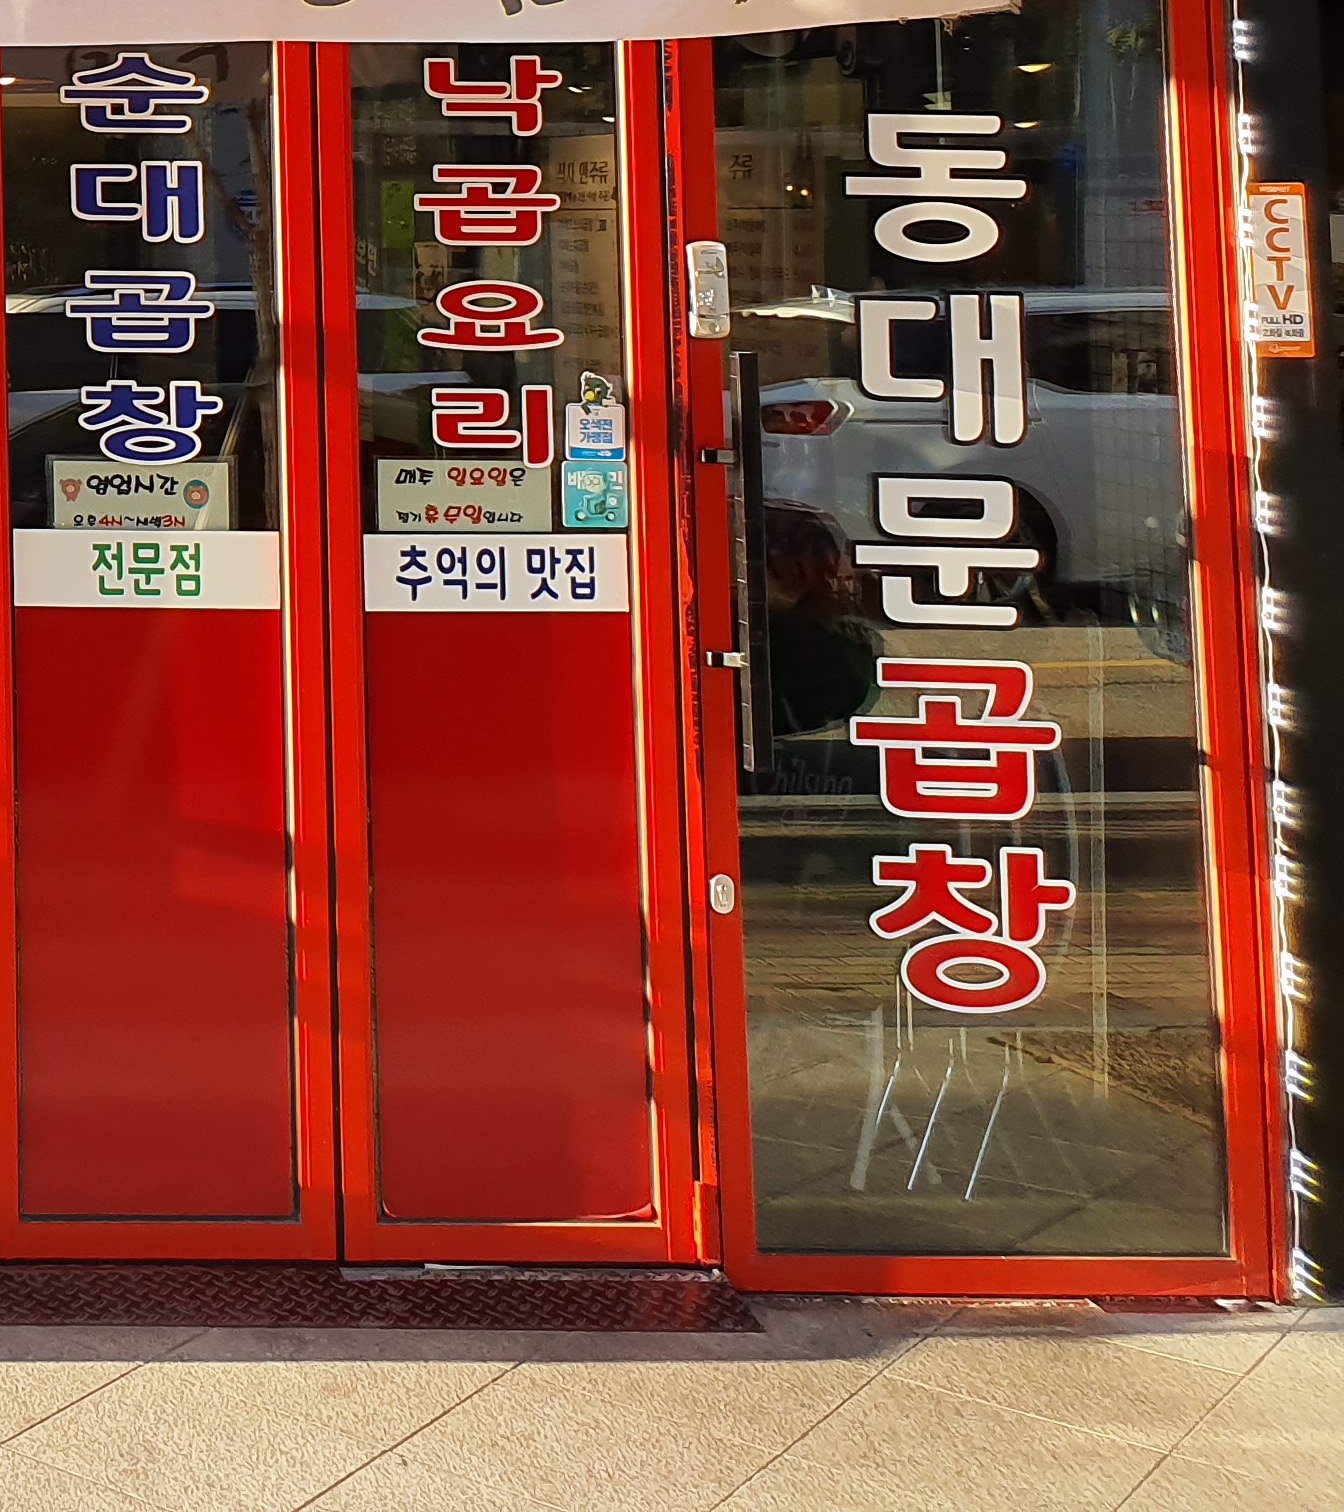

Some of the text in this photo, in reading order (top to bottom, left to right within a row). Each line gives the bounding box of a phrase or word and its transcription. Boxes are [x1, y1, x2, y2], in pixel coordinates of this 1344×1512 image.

[58, 51, 225, 467] 순대곱창
[413, 54, 566, 470] 낙곱요리
[1263, 198, 1295, 311] CCTV
[86, 472, 180, 497] 영업시간
[446, 465, 527, 488] 일요일은
[90, 540, 204, 599] 전문점
[394, 543, 598, 603] 추억의 맛집
[843, 110, 1077, 1015] 동대문곱창
